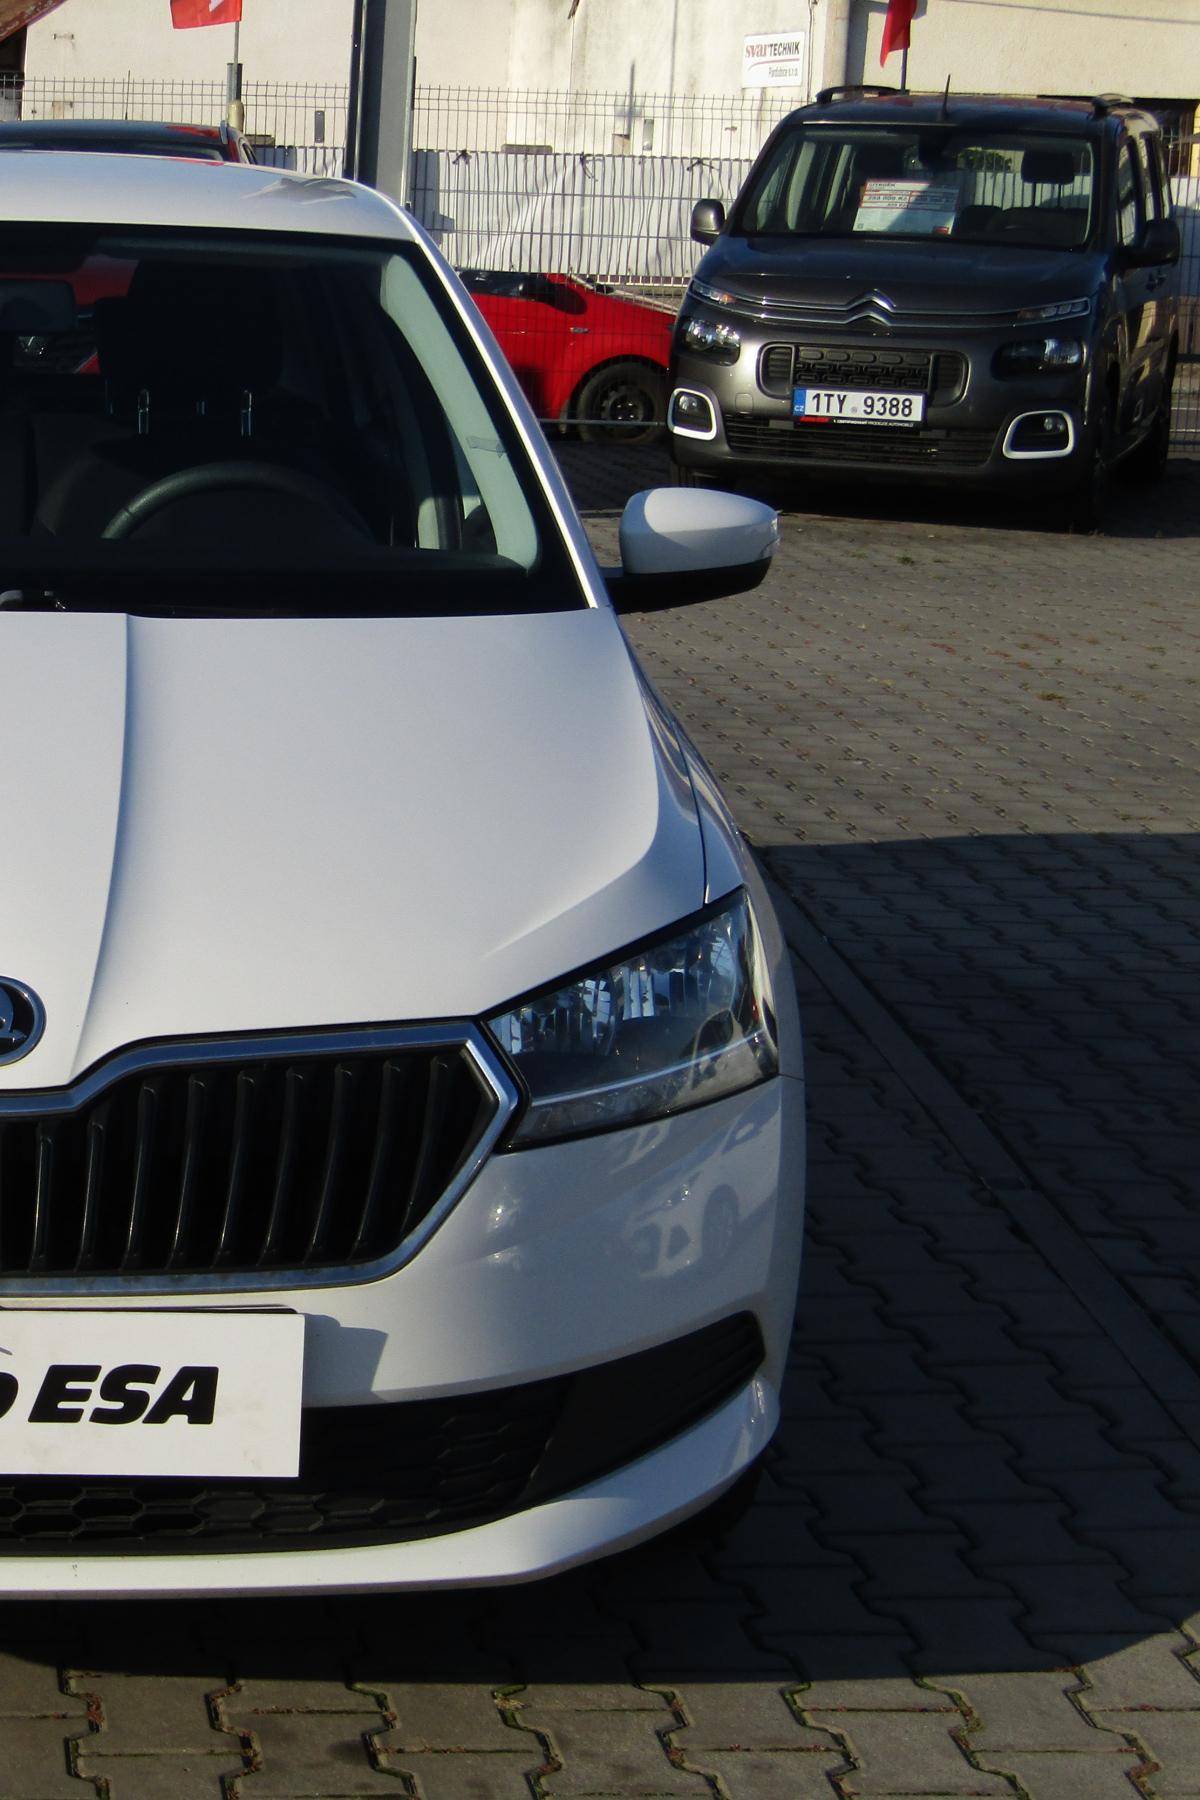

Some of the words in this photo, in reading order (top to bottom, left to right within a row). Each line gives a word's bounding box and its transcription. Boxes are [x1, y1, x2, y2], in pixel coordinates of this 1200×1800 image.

[793, 404, 805, 412] CZ
[811, 392, 847, 414] 1TY
[862, 395, 913, 417] 9388
[27, 1364, 219, 1425] ESA
